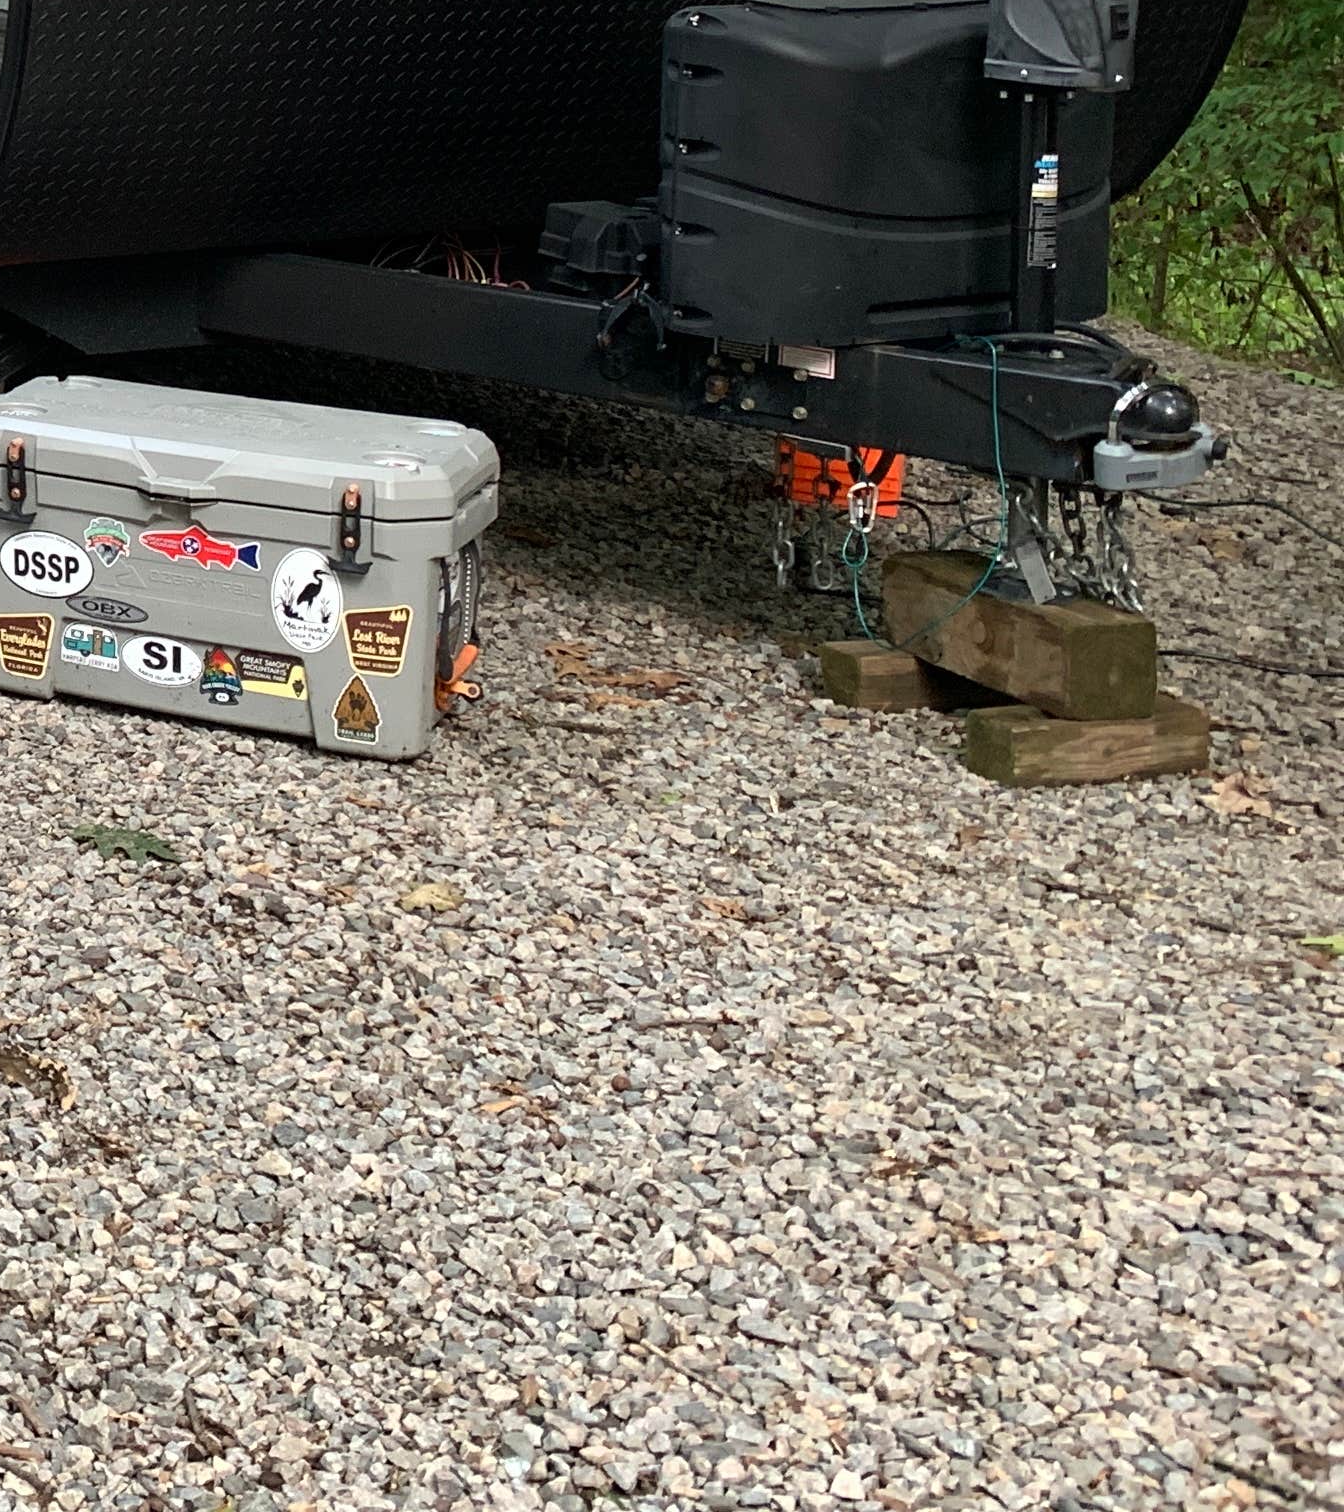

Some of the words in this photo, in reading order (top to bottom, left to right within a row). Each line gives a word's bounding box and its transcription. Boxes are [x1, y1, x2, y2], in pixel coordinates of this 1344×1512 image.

[14, 548, 79, 584] DSSP
[82, 600, 131, 618] OBX
[352, 628, 373, 643] Lost
[375, 631, 400, 645] River
[356, 642, 377, 655] State
[378, 644, 397, 656] Park
[142, 641, 182, 674] SI
[240, 655, 263, 665] GREAT
[8, 662, 39, 673] FLORIDA
[243, 663, 287, 676] MOUNTAINS
